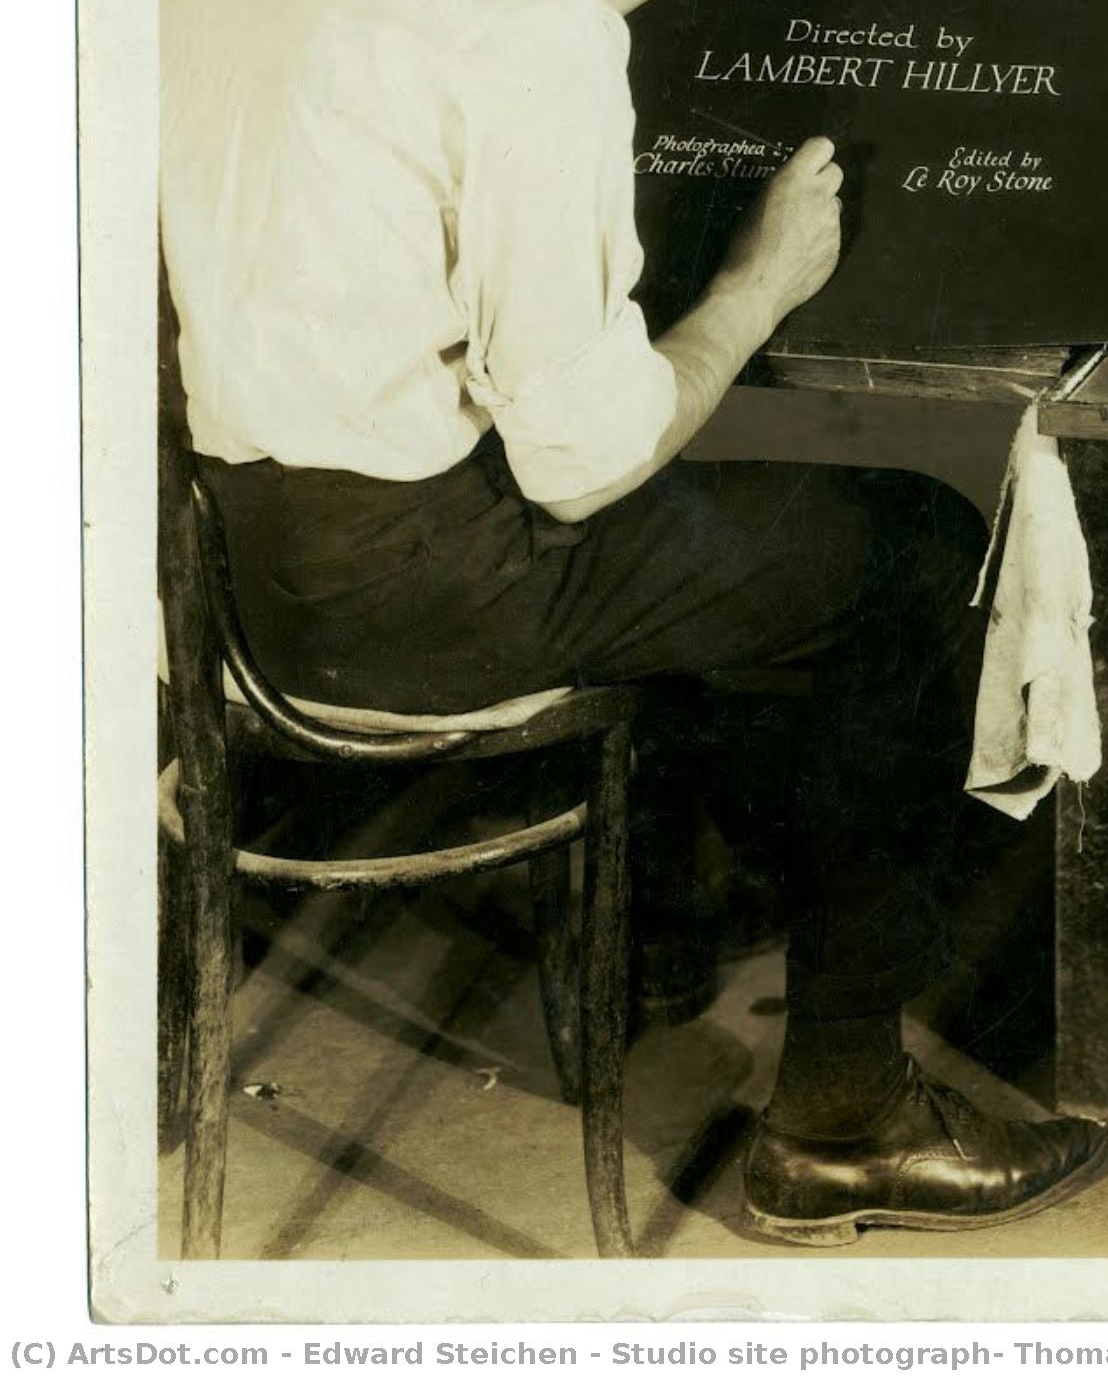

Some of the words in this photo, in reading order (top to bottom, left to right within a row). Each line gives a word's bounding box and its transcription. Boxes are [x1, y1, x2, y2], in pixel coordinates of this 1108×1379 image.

[785, 19, 918, 49] Directed
[937, 27, 974, 57] by
[694, 50, 895, 88] LAMBERT
[902, 60, 1062, 97] HILLYER
[633, 152, 715, 178] Charles
[949, 146, 1014, 170] Edited
[1020, 152, 1043, 171] by
[901, 166, 929, 193] Le
[936, 169, 983, 196] Roy
[985, 170, 1053, 193] Stone
